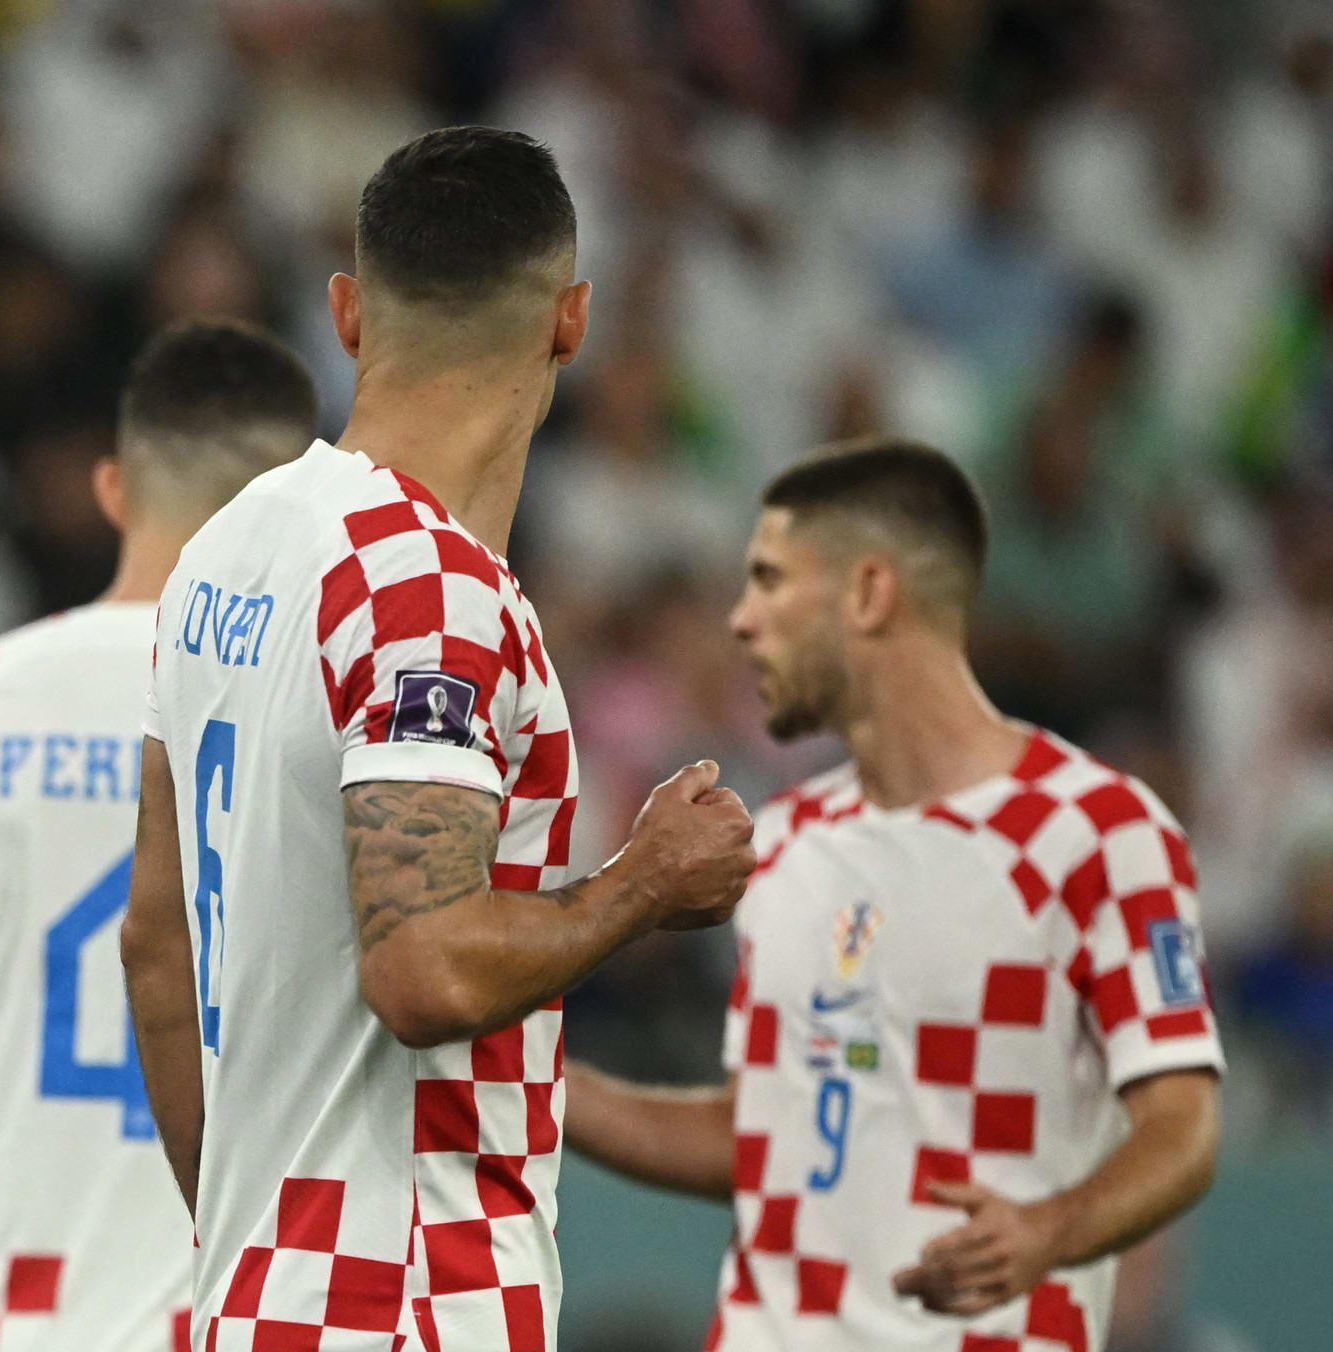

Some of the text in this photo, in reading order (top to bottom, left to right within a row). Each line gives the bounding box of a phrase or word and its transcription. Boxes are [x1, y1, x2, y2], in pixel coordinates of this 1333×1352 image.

[39, 848, 158, 1142] 4
[195, 719, 237, 1057] 6
[806, 1076, 852, 1192] 9
